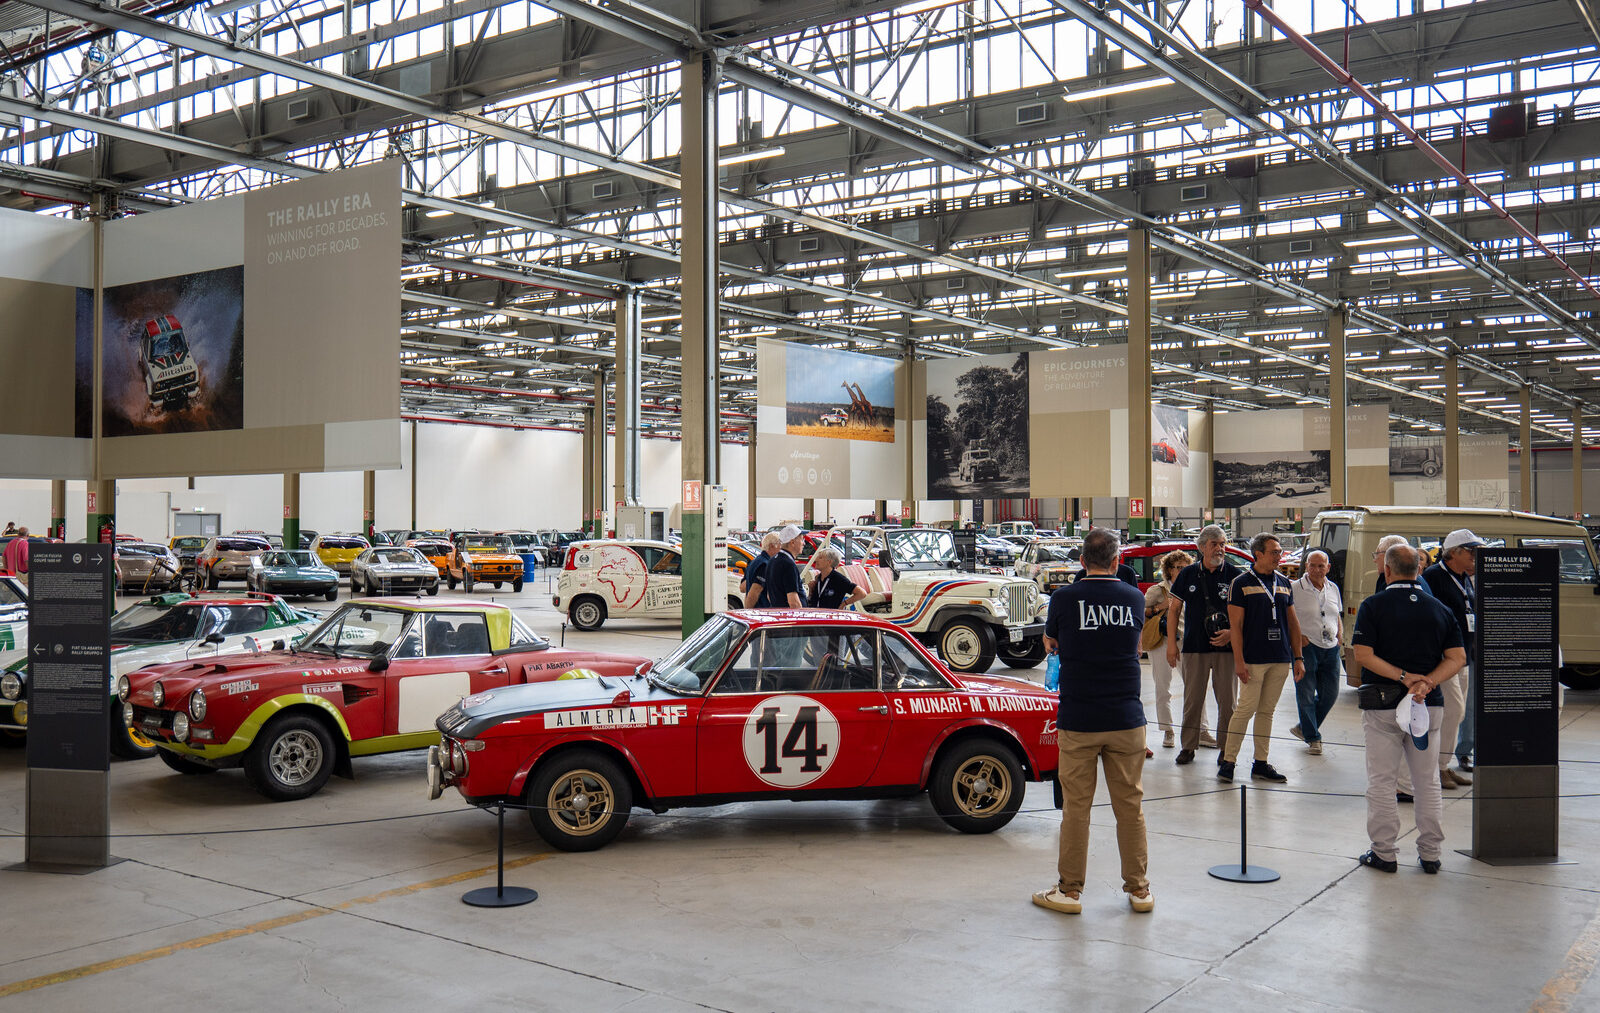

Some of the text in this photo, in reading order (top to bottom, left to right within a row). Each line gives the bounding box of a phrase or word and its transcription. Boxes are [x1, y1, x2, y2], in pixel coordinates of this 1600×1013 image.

[267, 191, 372, 228] THE RALLY ERA
[267, 212, 388, 247] WINNING FOR DECADES,
[267, 237, 361, 265] ON AND OFF ROAD.
[156, 364, 193, 380] Alitalia
[1043, 358, 1125, 373] EPIC JOURNEYS
[1044, 370, 1105, 382] THE ADVENTURE
[1078, 600, 1135, 630] LANCIA
[336, 666, 366, 674] VERINI
[528, 661, 574, 672] FIAT ABARTH
[221, 680, 250, 689] OLIO
[230, 683, 258, 694] FIAT
[894, 698, 908, 715] S.
[909, 697, 963, 714] MUNARI
[969, 697, 985, 712] M.
[986, 697, 1054, 711] MANNUCCI
[556, 704, 688, 727] ALMERIA HF
[756, 706, 828, 774] 14
